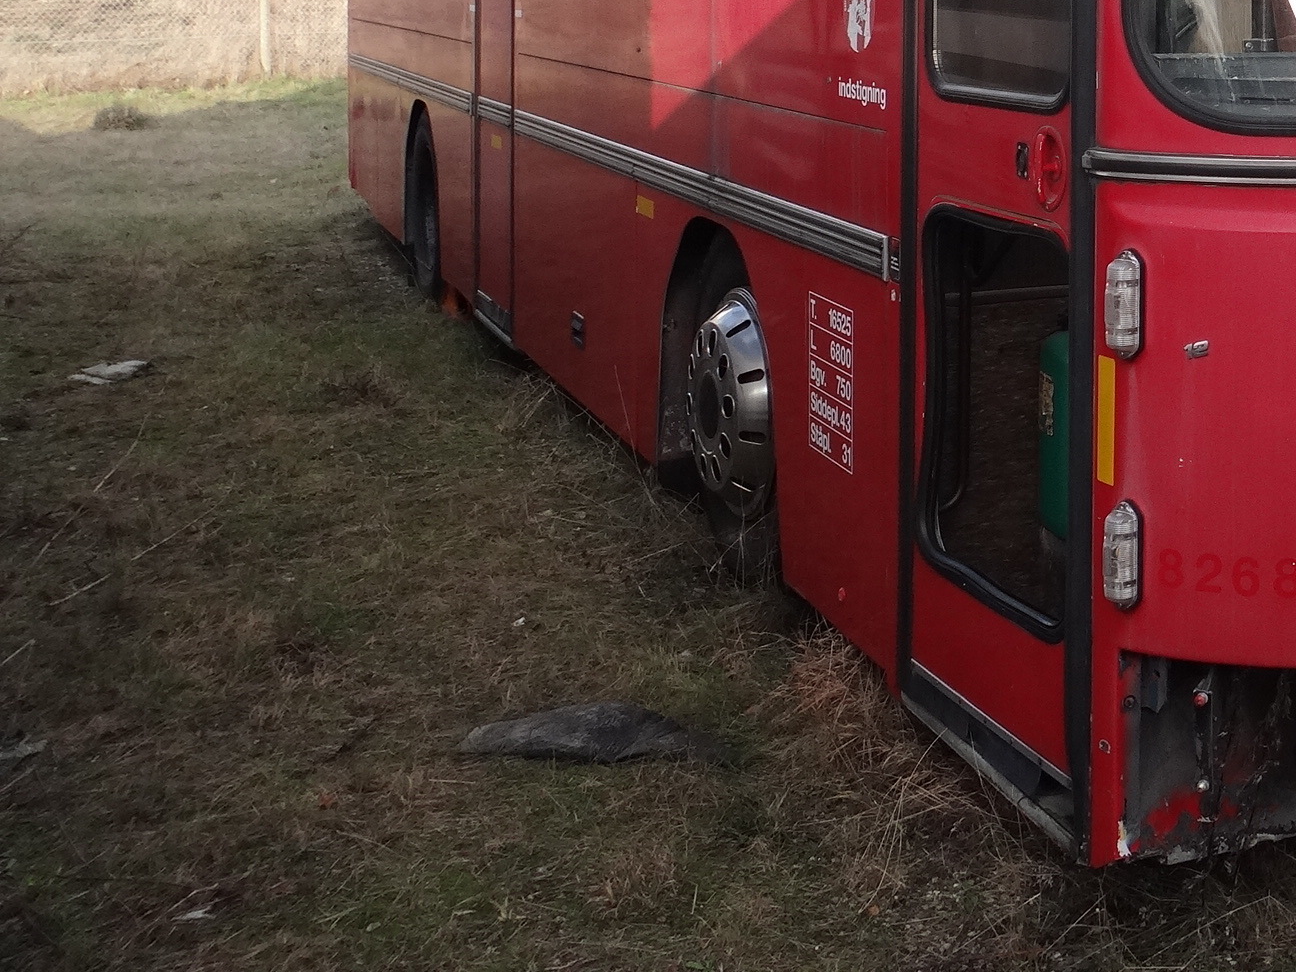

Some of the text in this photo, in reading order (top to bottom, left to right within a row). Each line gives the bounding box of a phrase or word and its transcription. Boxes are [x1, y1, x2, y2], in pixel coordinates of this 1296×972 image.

[838, 77, 887, 110] indstigning
[810, 299, 851, 336] T. 16525
[810, 330, 851, 368] L 6800
[810, 360, 851, 401] Bgv. 750
[840, 414, 851, 434] 43
[841, 444, 851, 467] 31
